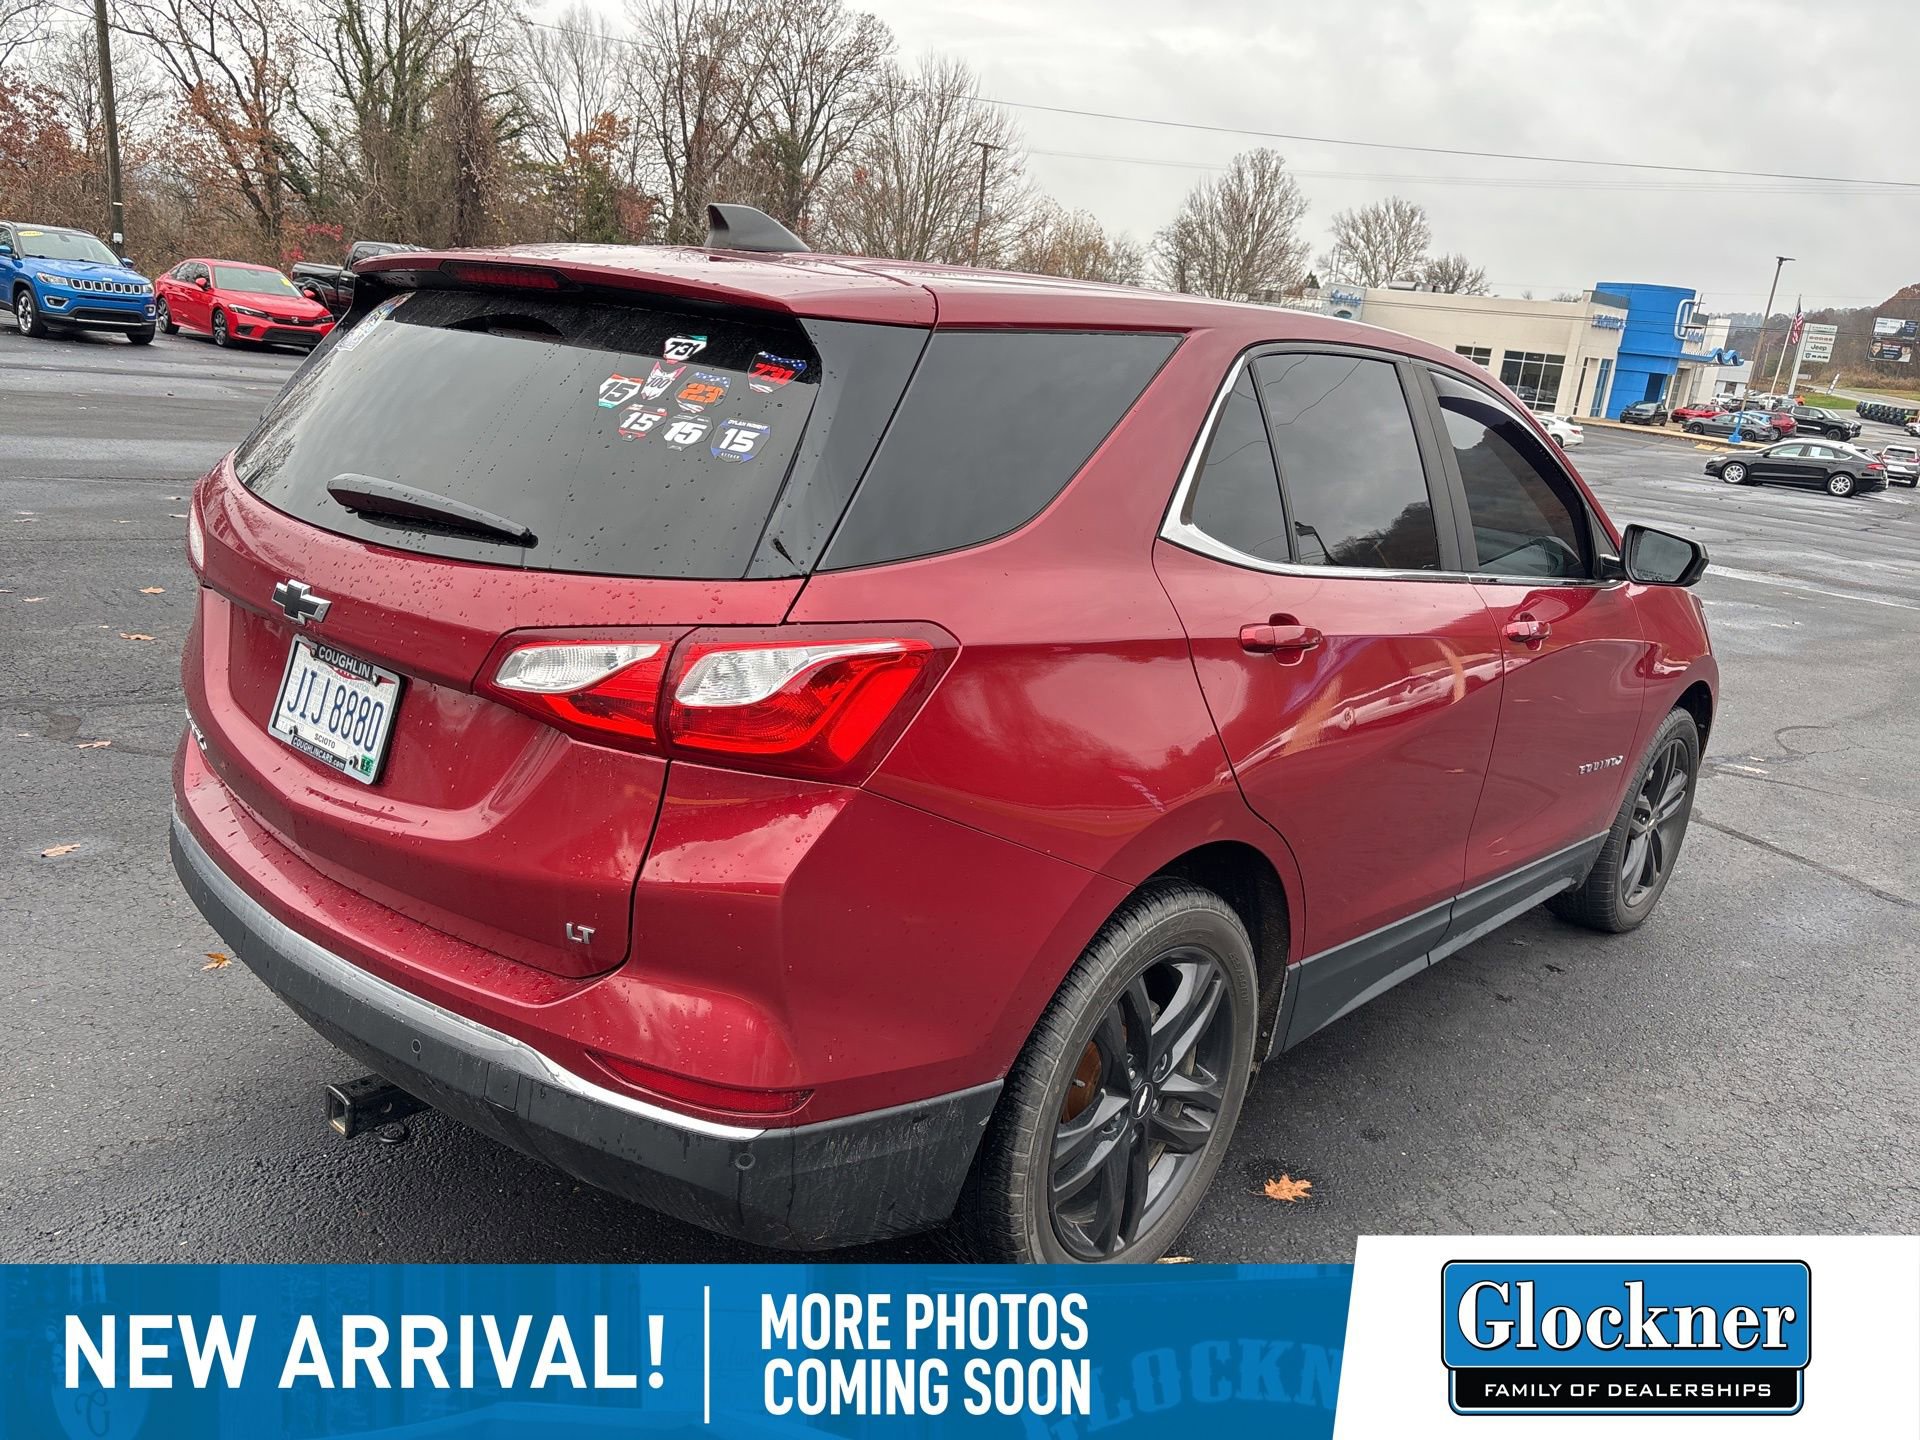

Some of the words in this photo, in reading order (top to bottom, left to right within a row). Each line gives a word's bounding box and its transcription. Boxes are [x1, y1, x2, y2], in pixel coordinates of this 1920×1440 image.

[665, 341, 701, 357] 731
[1810, 343, 1828, 351] Jeep
[603, 381, 636, 400] 15
[620, 411, 662, 432] 15
[664, 421, 708, 445] 15
[719, 428, 761, 453] 15
[318, 645, 371, 679] COUGHLIN
[286, 667, 331, 725] JIJ
[328, 684, 385, 753] 8880
[314, 732, 336, 749] SCIOTO
[292, 736, 346, 770] COUGHLINCARS.com
[565, 921, 597, 945] LT
